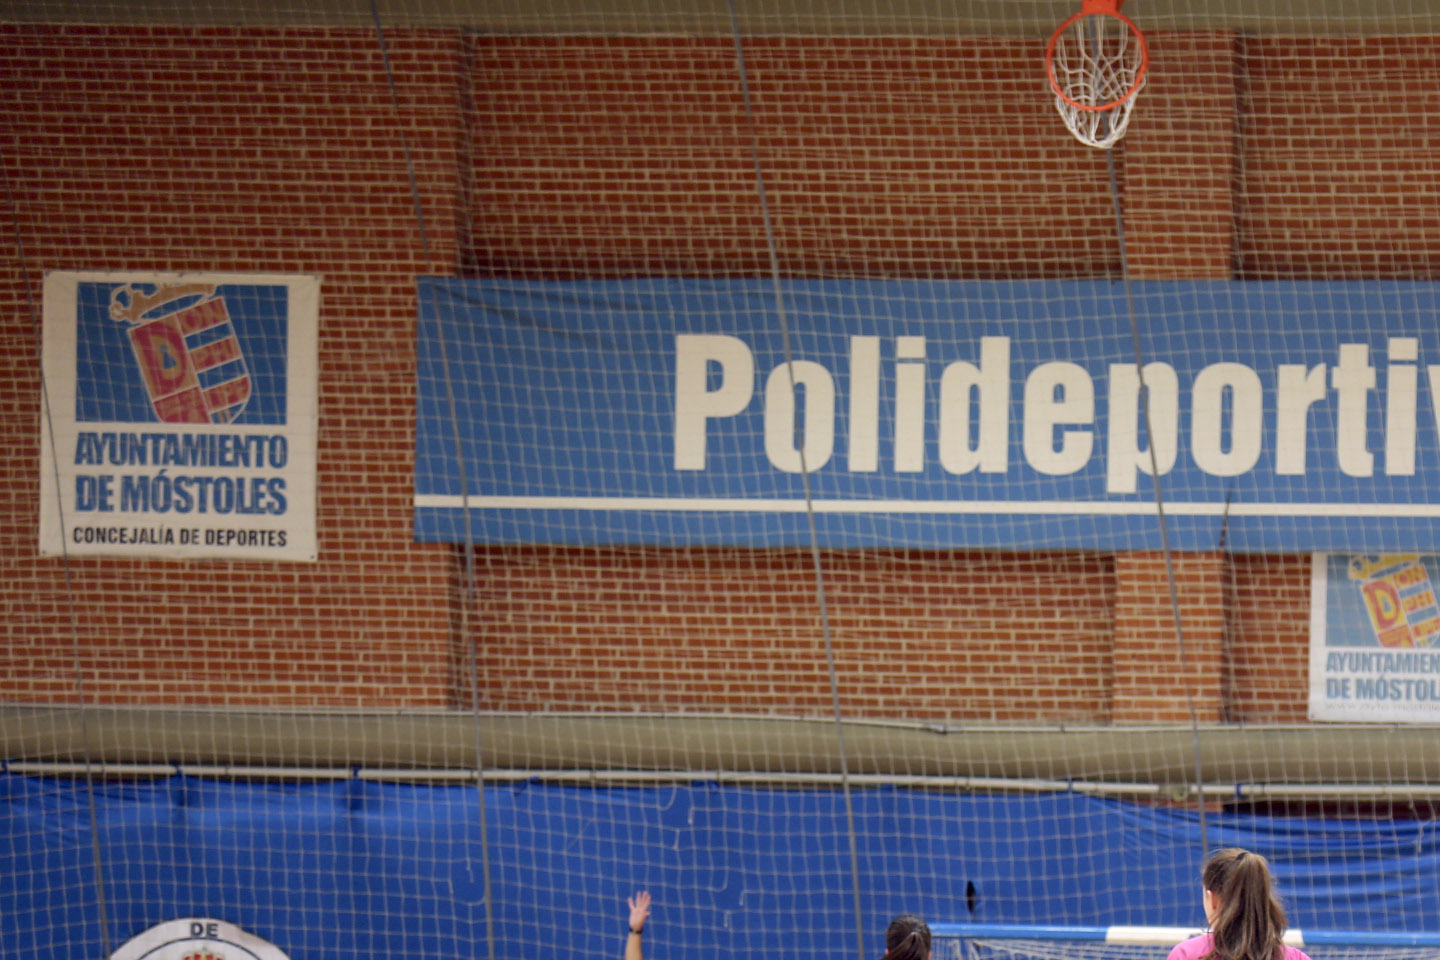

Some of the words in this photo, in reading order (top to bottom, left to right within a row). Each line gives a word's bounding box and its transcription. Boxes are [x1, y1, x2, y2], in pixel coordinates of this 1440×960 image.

[74, 431, 288, 468] AYUNTAMIENTO
[75, 474, 114, 512] DE
[120, 469, 288, 515] MÓSTOLES
[73, 525, 174, 545] CONCEJALÍA
[180, 528, 200, 546] DE
[205, 528, 287, 547] DEPORTES
[1326, 678, 1351, 700] DE
[190, 922, 219, 938] DE
